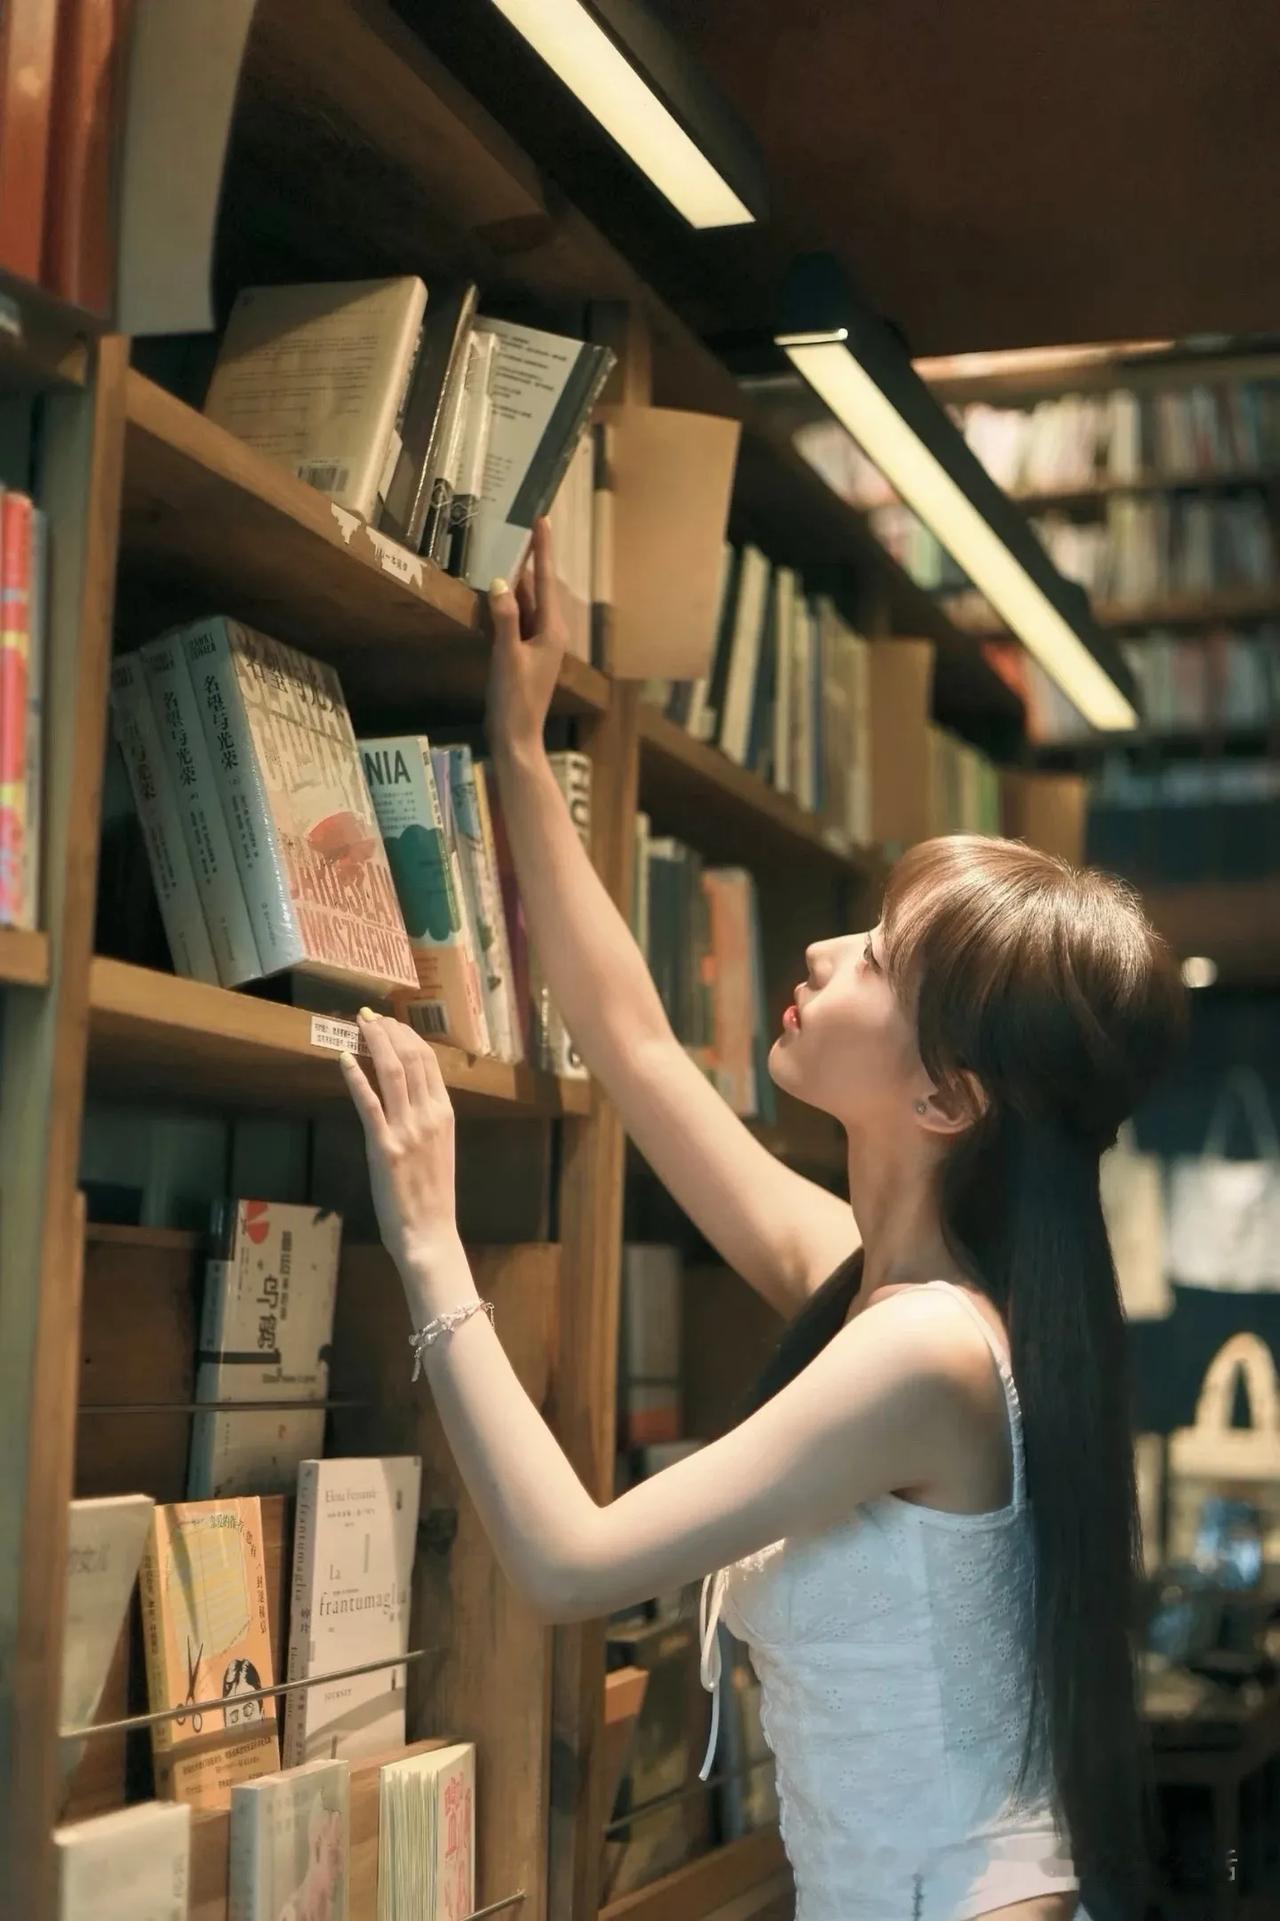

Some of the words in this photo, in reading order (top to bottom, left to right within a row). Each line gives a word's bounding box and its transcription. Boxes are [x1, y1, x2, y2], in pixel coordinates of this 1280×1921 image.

[205, 675, 238, 770] 名望与光荣
[329, 1564, 342, 1581] La
